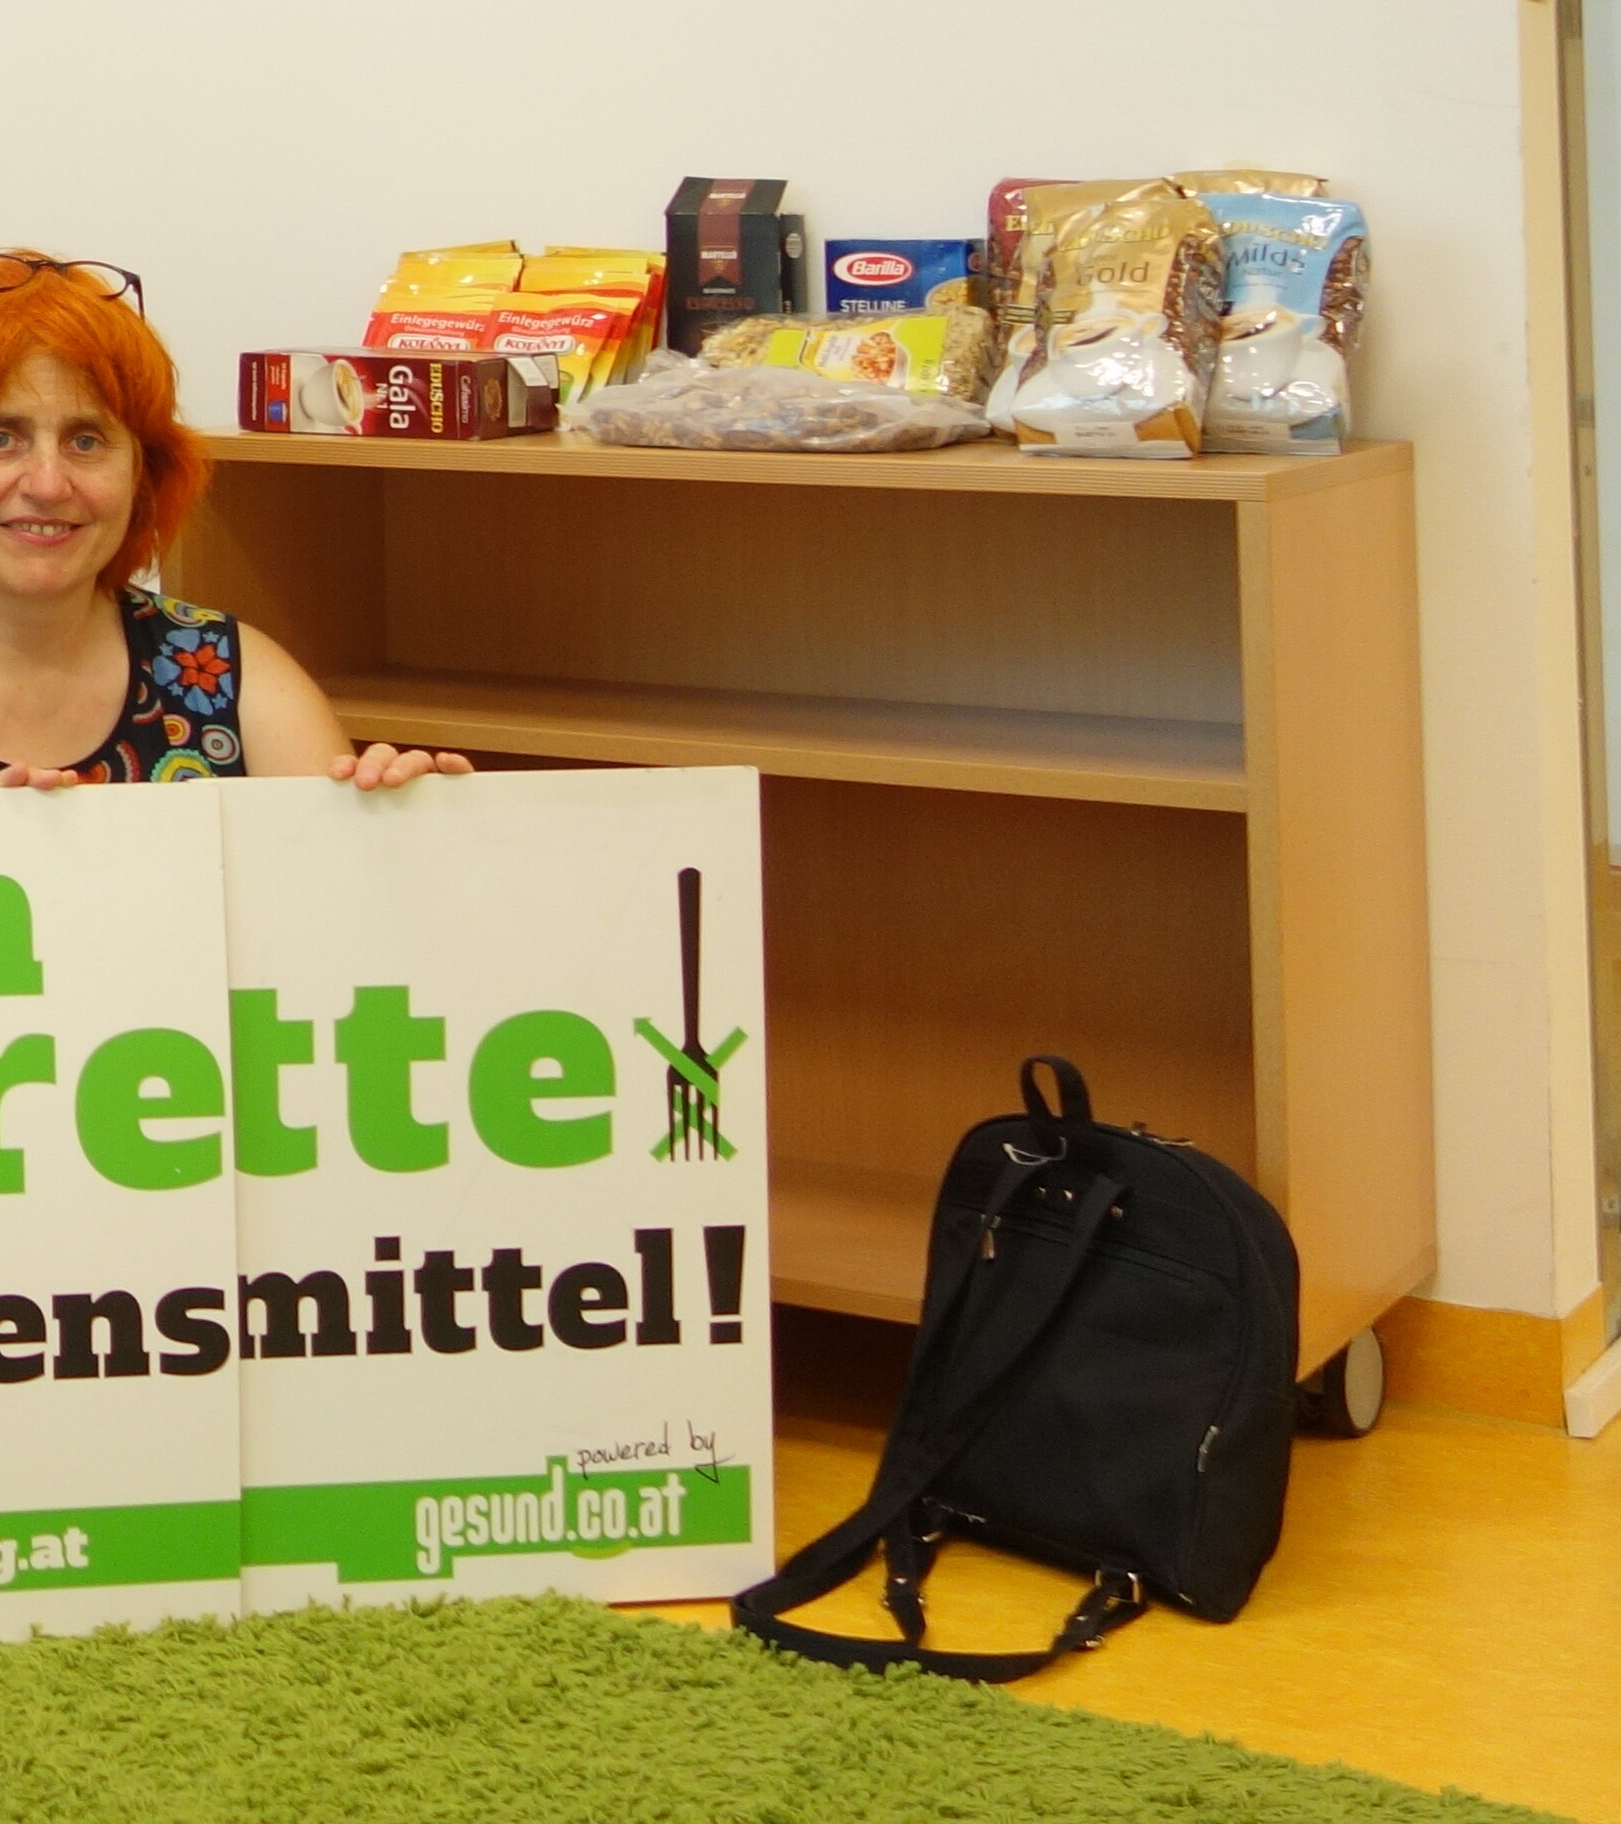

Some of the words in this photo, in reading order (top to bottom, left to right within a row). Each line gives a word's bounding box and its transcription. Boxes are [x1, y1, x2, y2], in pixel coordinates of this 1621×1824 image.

[851, 260, 906, 276] Barilla
[839, 299, 908, 313] STELLINE
[388, 364, 417, 429] Gala
[429, 362, 444, 434] EDUSCHO
[576, 1419, 672, 1476] powered
[687, 1421, 733, 1482] by
[414, 1463, 686, 1574] gesund.co.at
